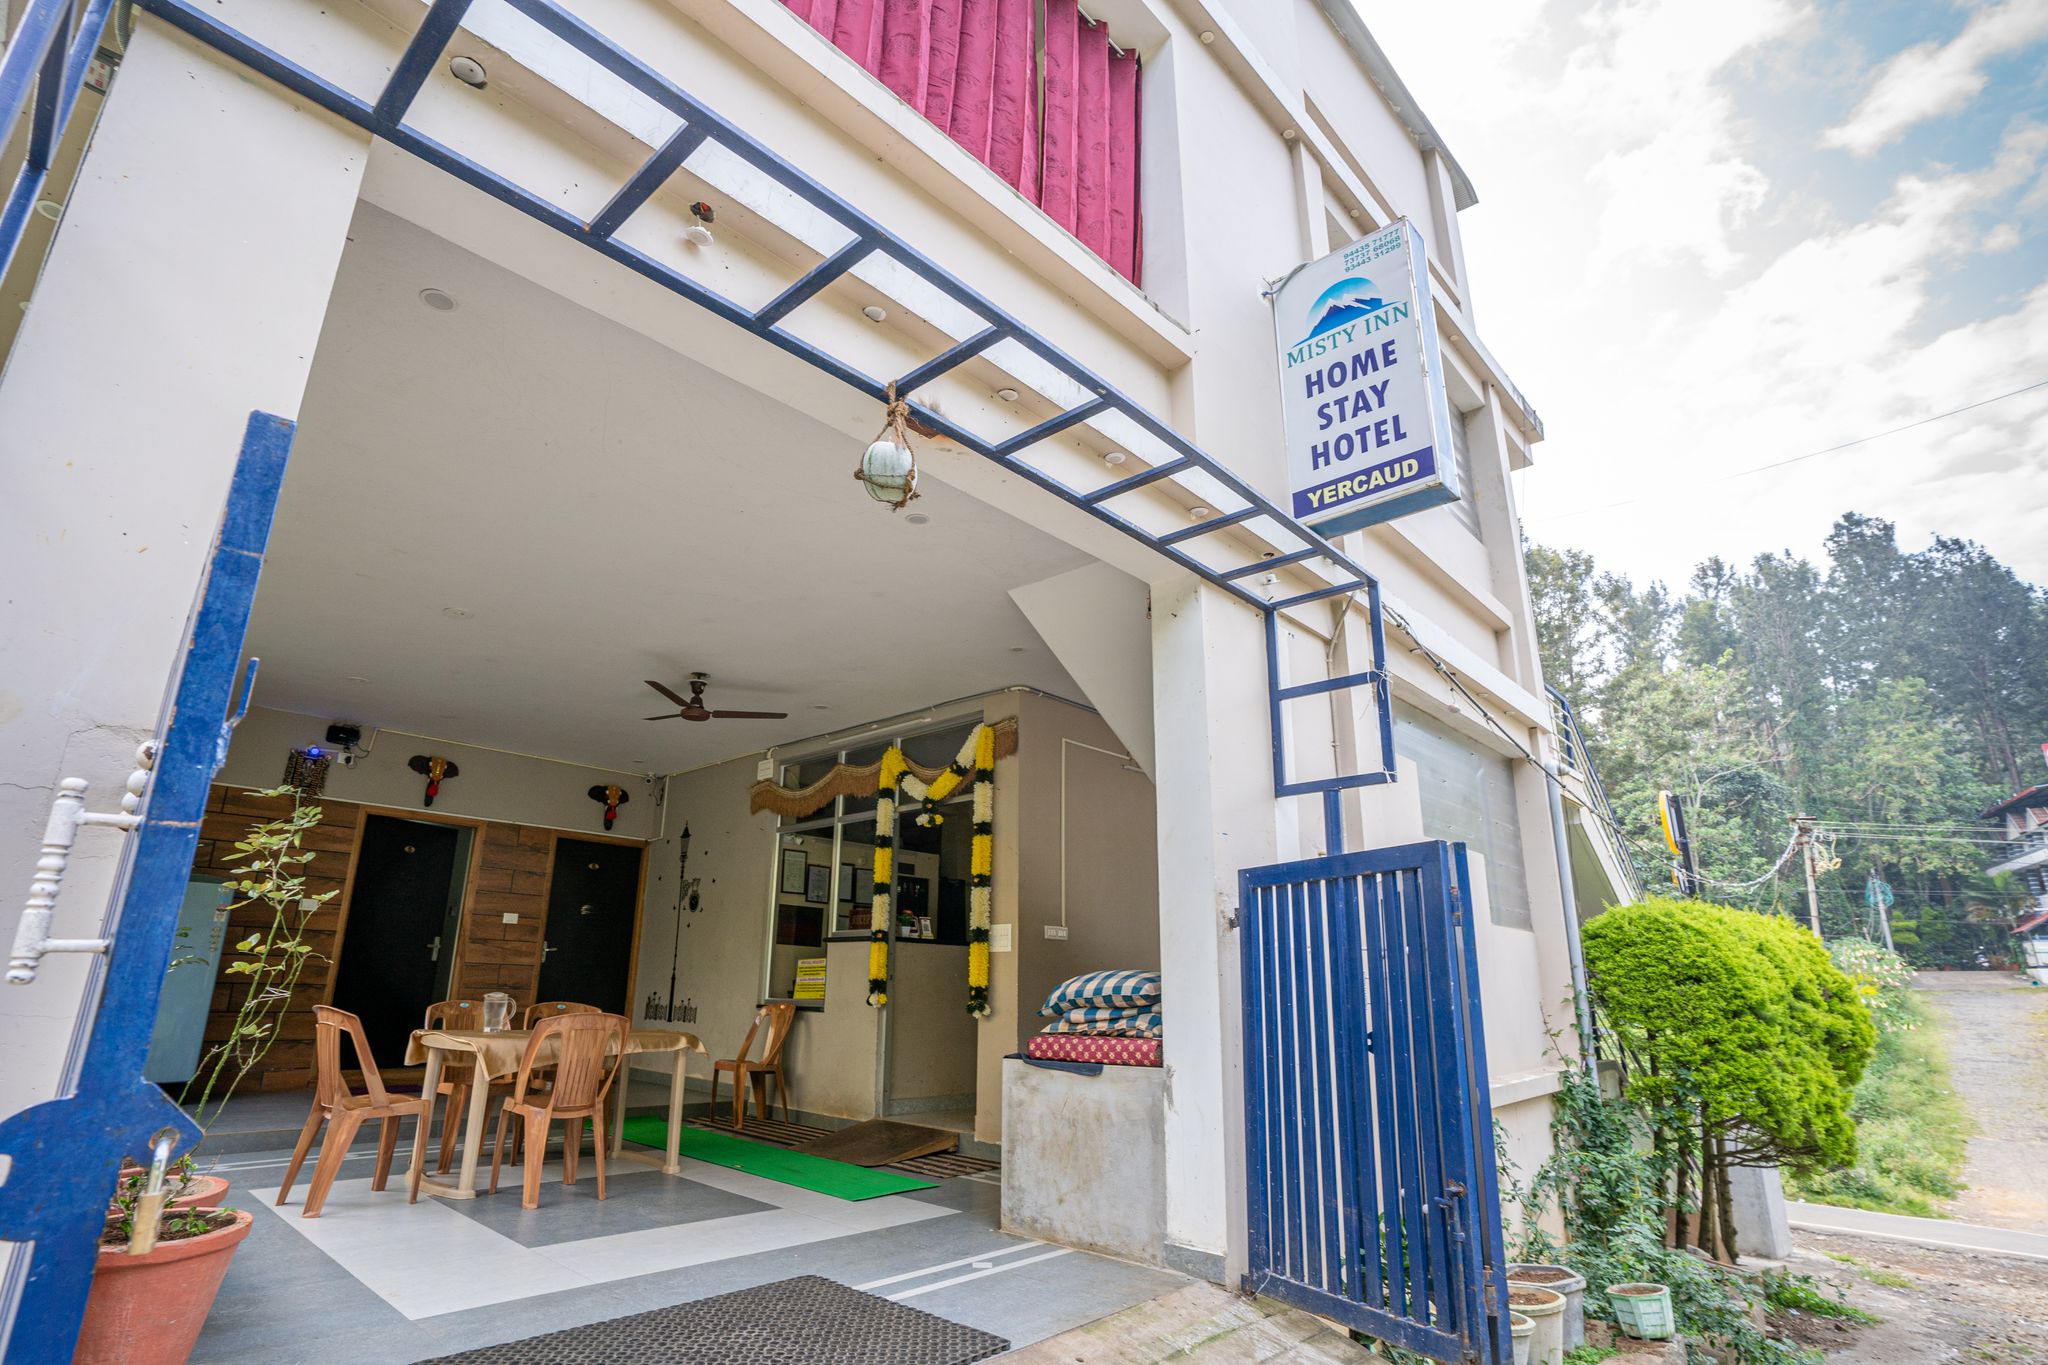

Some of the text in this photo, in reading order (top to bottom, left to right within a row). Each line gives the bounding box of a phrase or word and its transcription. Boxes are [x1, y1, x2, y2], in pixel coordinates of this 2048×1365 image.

[1287, 301, 1408, 368] MISTY INN
[1305, 339, 1398, 399] HOME
[1317, 379, 1390, 431] STAY
[1311, 414, 1408, 471] HOTEL
[1307, 458, 1419, 508] YERCAUD
